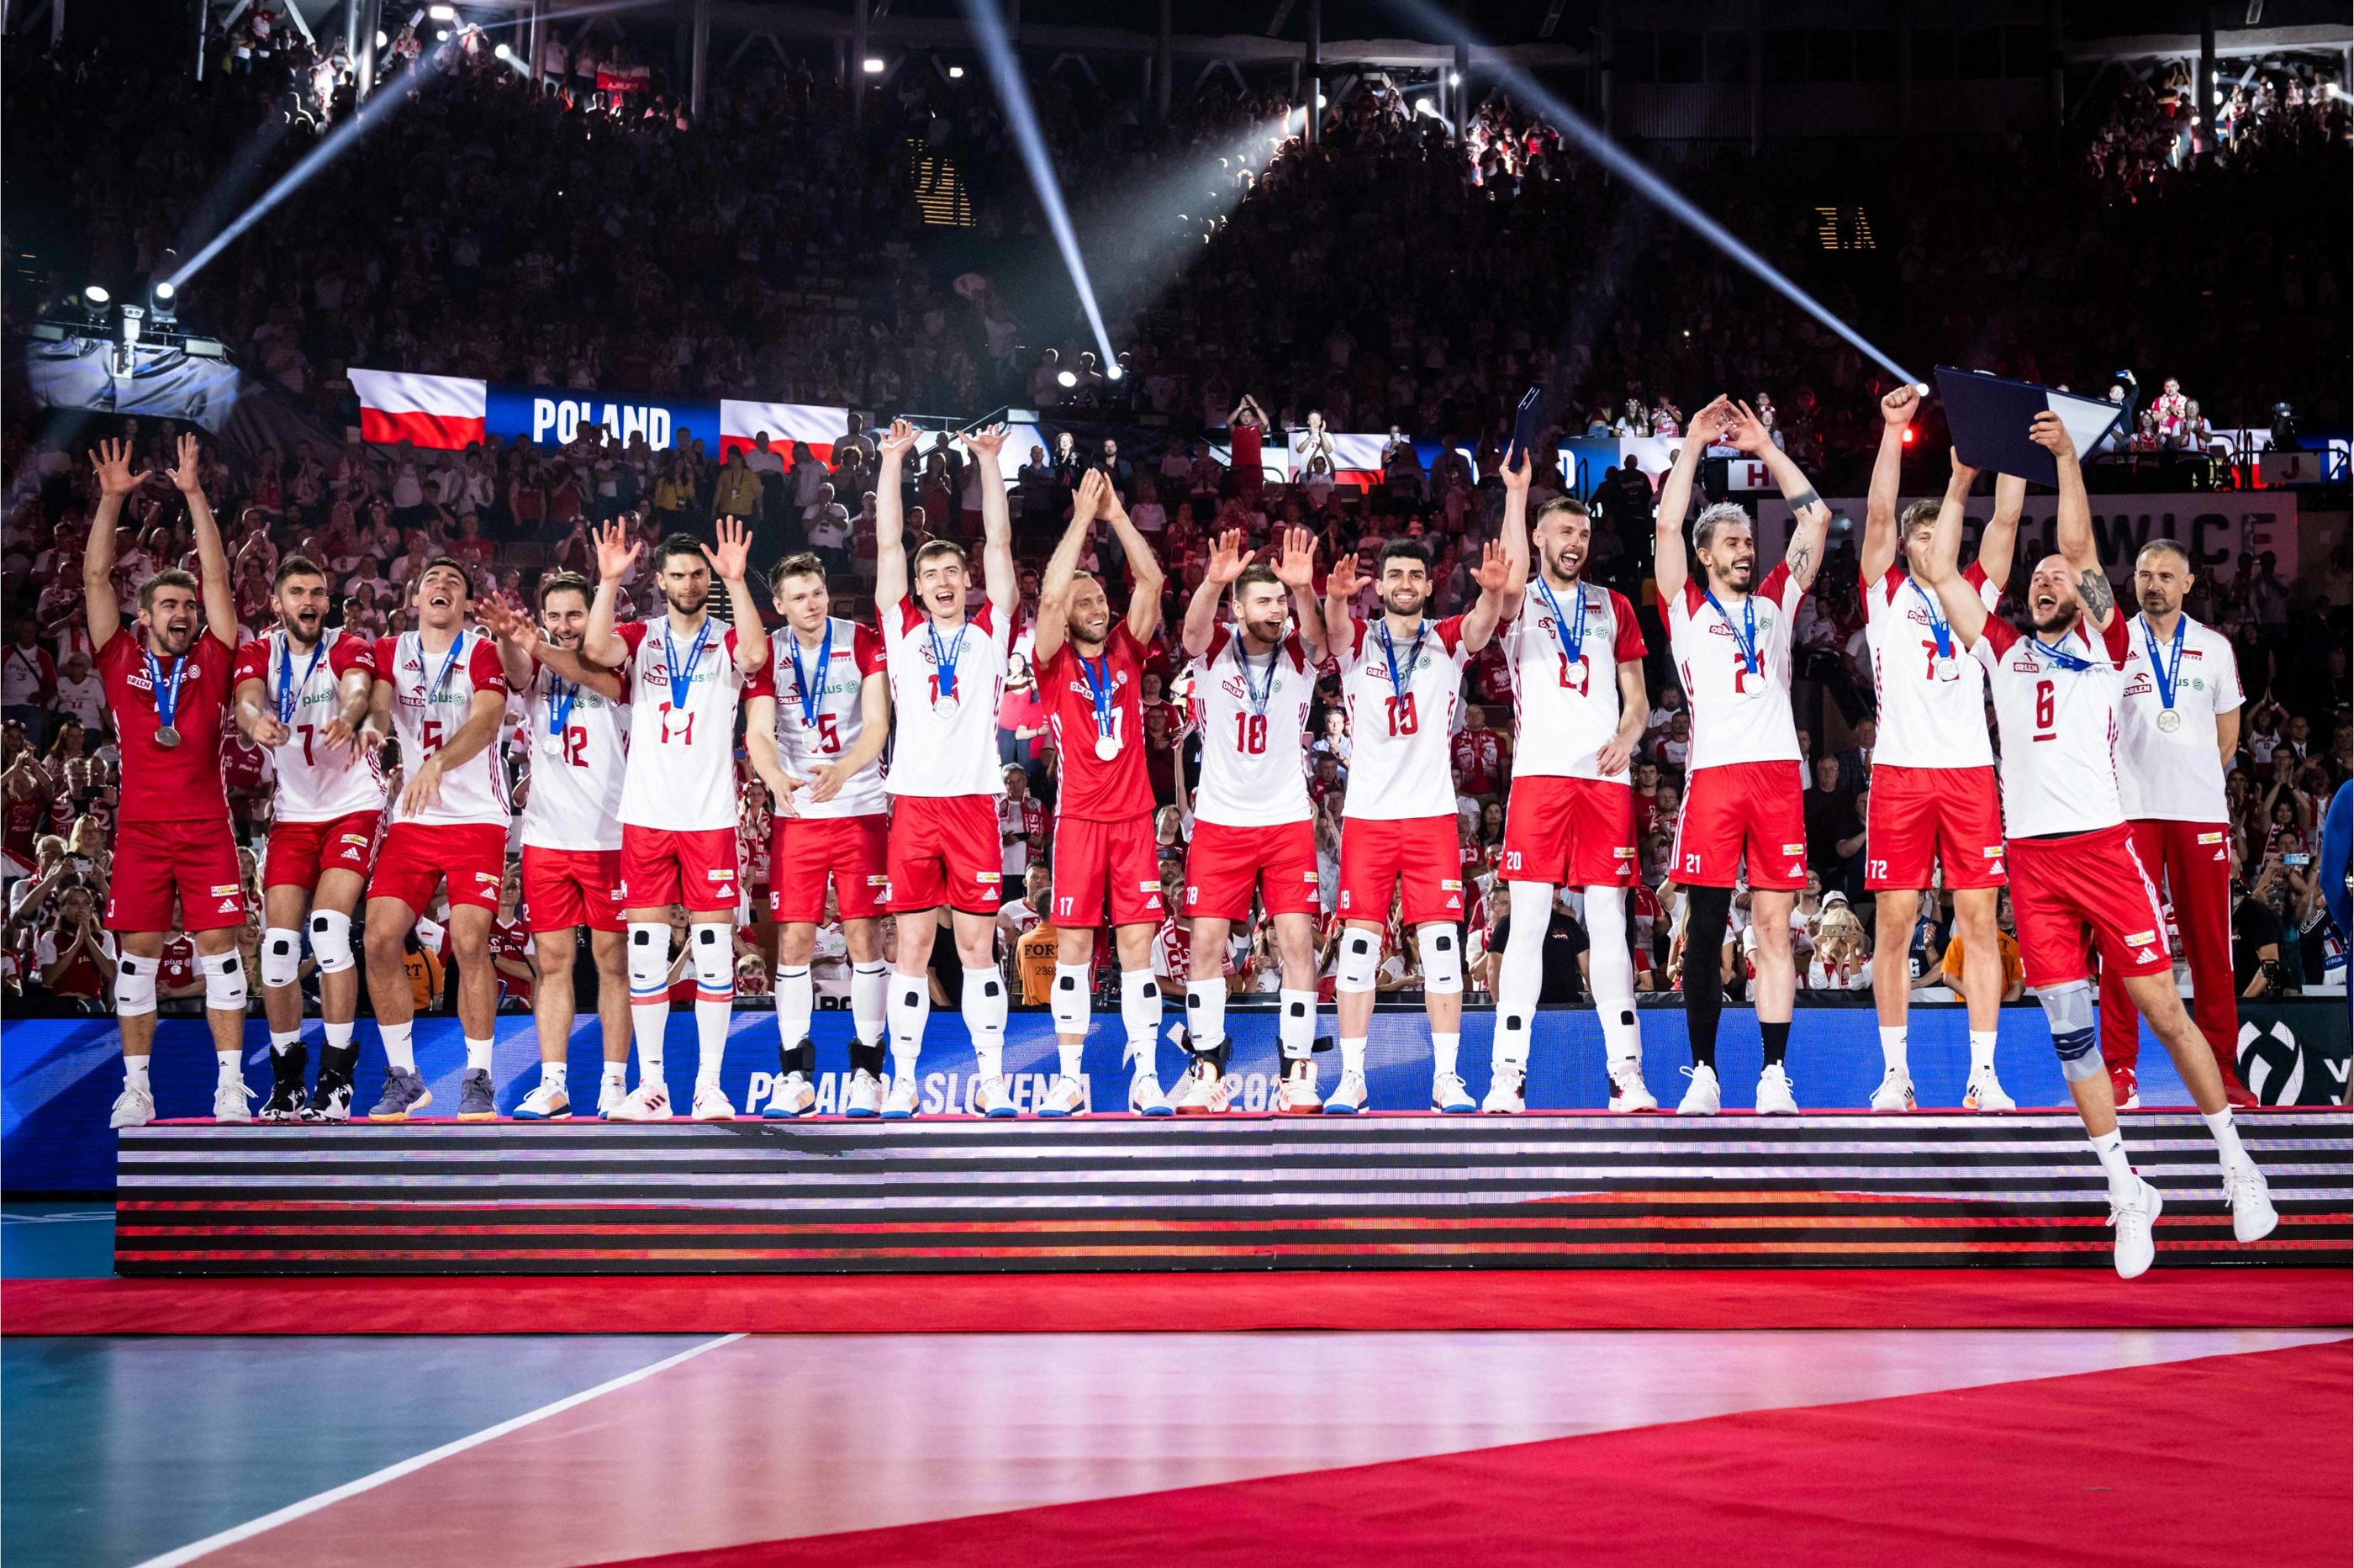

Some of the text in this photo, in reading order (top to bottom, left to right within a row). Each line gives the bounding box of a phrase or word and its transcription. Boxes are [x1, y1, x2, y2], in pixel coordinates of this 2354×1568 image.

[1748, 463, 1770, 487] H
[2282, 456, 2299, 479] J
[1367, 668, 1391, 680] ORLE
[1734, 648, 1765, 694] 21
[2014, 663, 2039, 673] ORLEN
[644, 673, 668, 686] ORLEN
[2176, 678, 2189, 687] us
[823, 684, 842, 694] lus
[1071, 682, 1093, 700] OREN
[1222, 682, 1243, 698] ORLEN
[1251, 689, 1265, 701] plu
[2124, 685, 2151, 696] ORLEN
[303, 692, 326, 707] plus
[2036, 679, 2054, 729] 6
[1385, 692, 1418, 736] 19
[424, 721, 442, 762] 5
[1235, 712, 1268, 754] 18
[297, 724, 314, 766] 7
[562, 724, 588, 768] 12
[239, 763, 252, 772] plus
[1507, 852, 1522, 870] 20
[1686, 854, 1701, 874] 21
[1871, 860, 1887, 879] 72
[1186, 886, 1198, 905] 18
[1340, 890, 1350, 909] 19
[523, 903, 531, 921] 2
[1059, 897, 1074, 916] 17
[1024, 943, 1058, 956] FOR
[164, 958, 182, 967] plus
[404, 964, 422, 976] RT
[2325, 956, 2343, 966] ITALIA
[1035, 966, 1055, 976] 239
[746, 1072, 1092, 1115] PAN SLOEN
